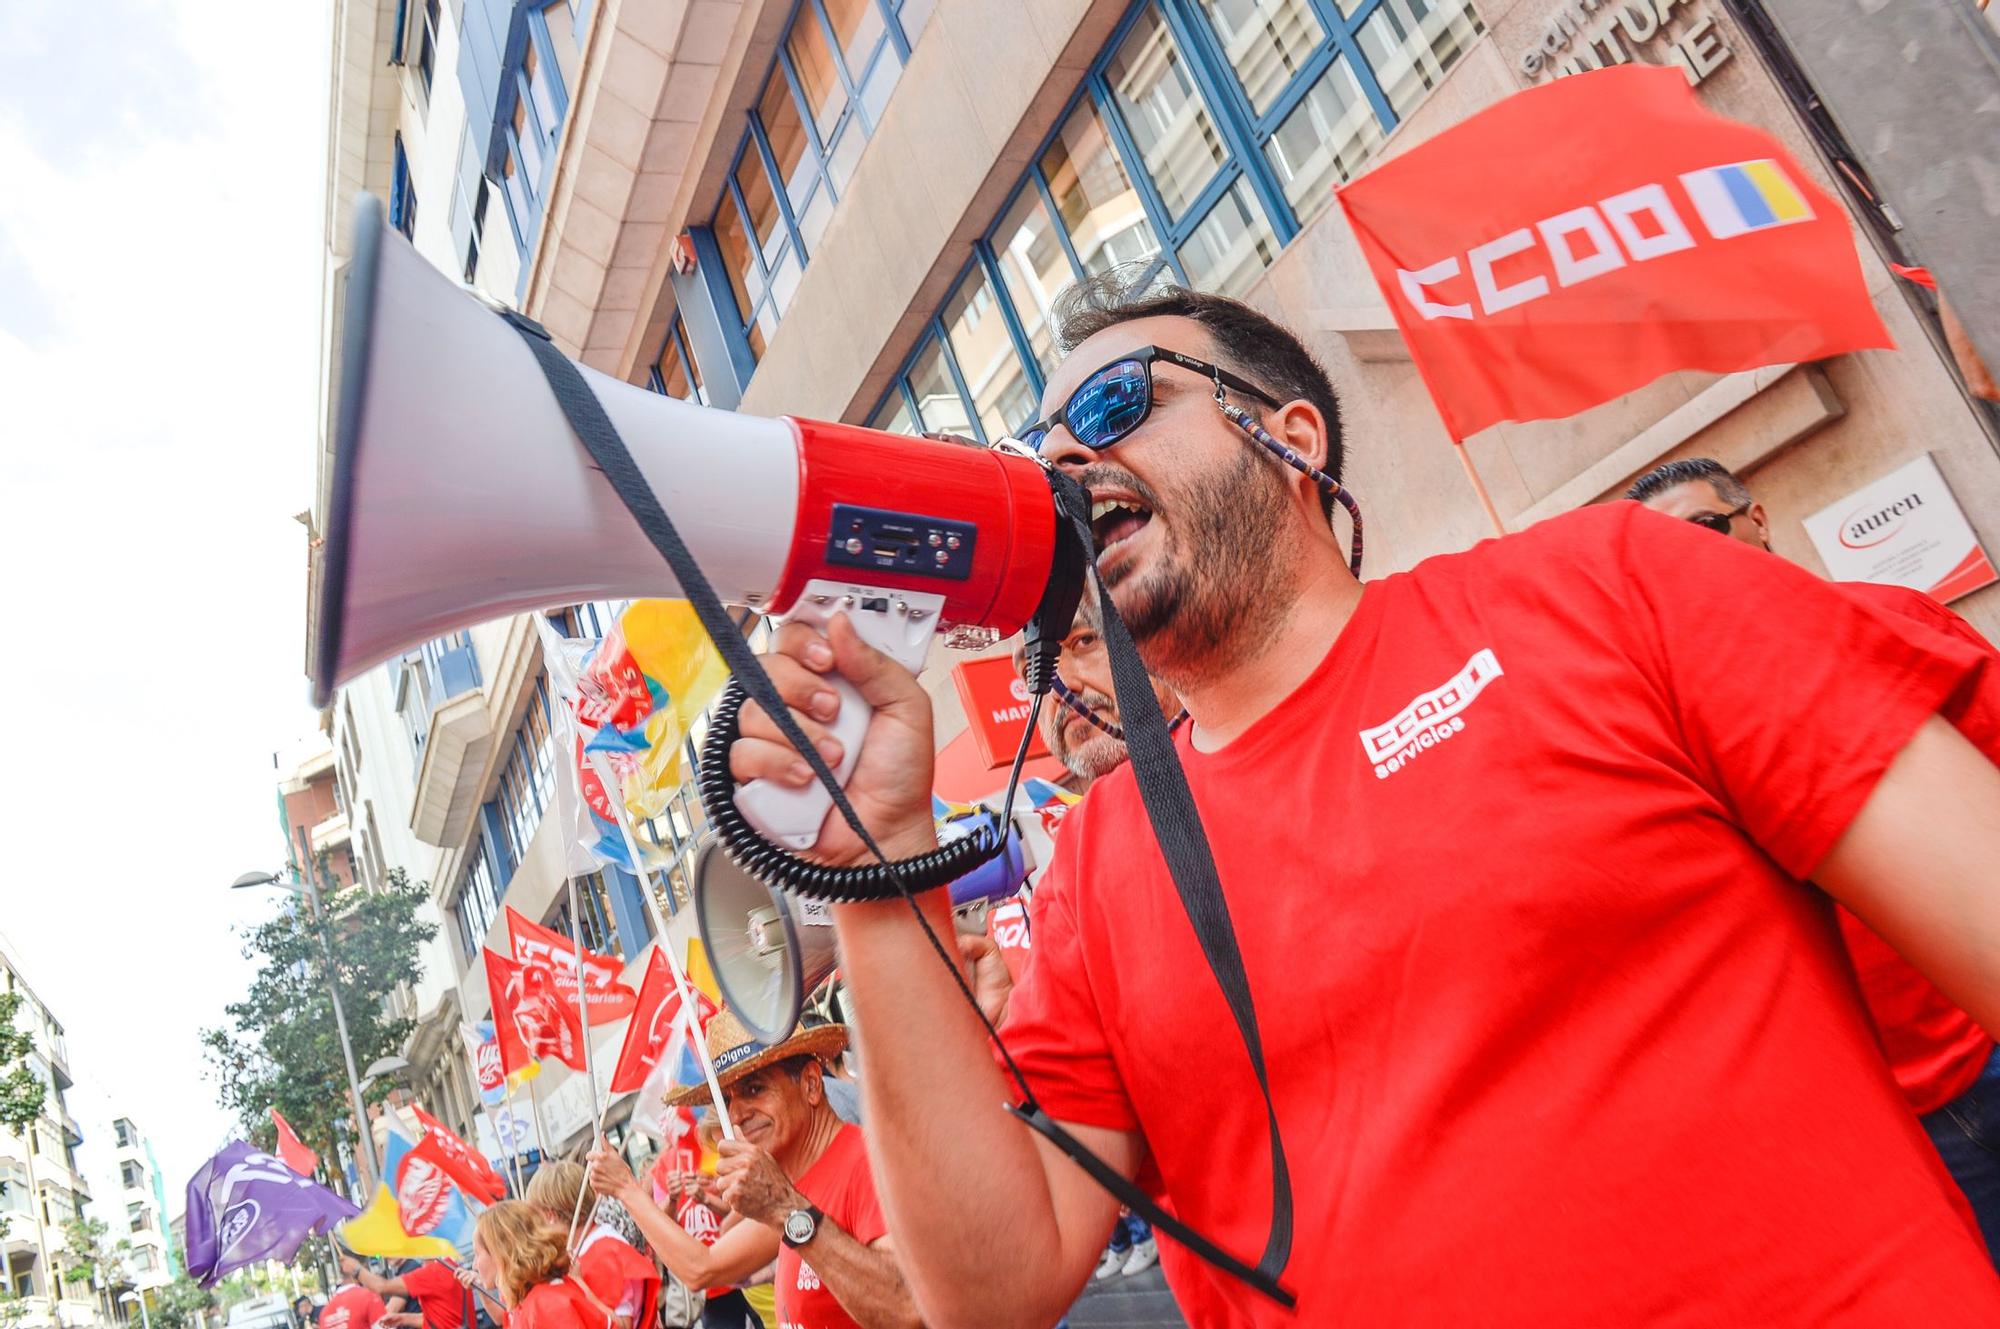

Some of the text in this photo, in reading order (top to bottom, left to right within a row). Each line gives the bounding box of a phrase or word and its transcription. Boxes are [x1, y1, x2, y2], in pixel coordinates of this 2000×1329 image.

[1396, 183, 1697, 321] CCOO
[1850, 492, 1924, 539] auren
[1374, 716, 1466, 780] servicios
